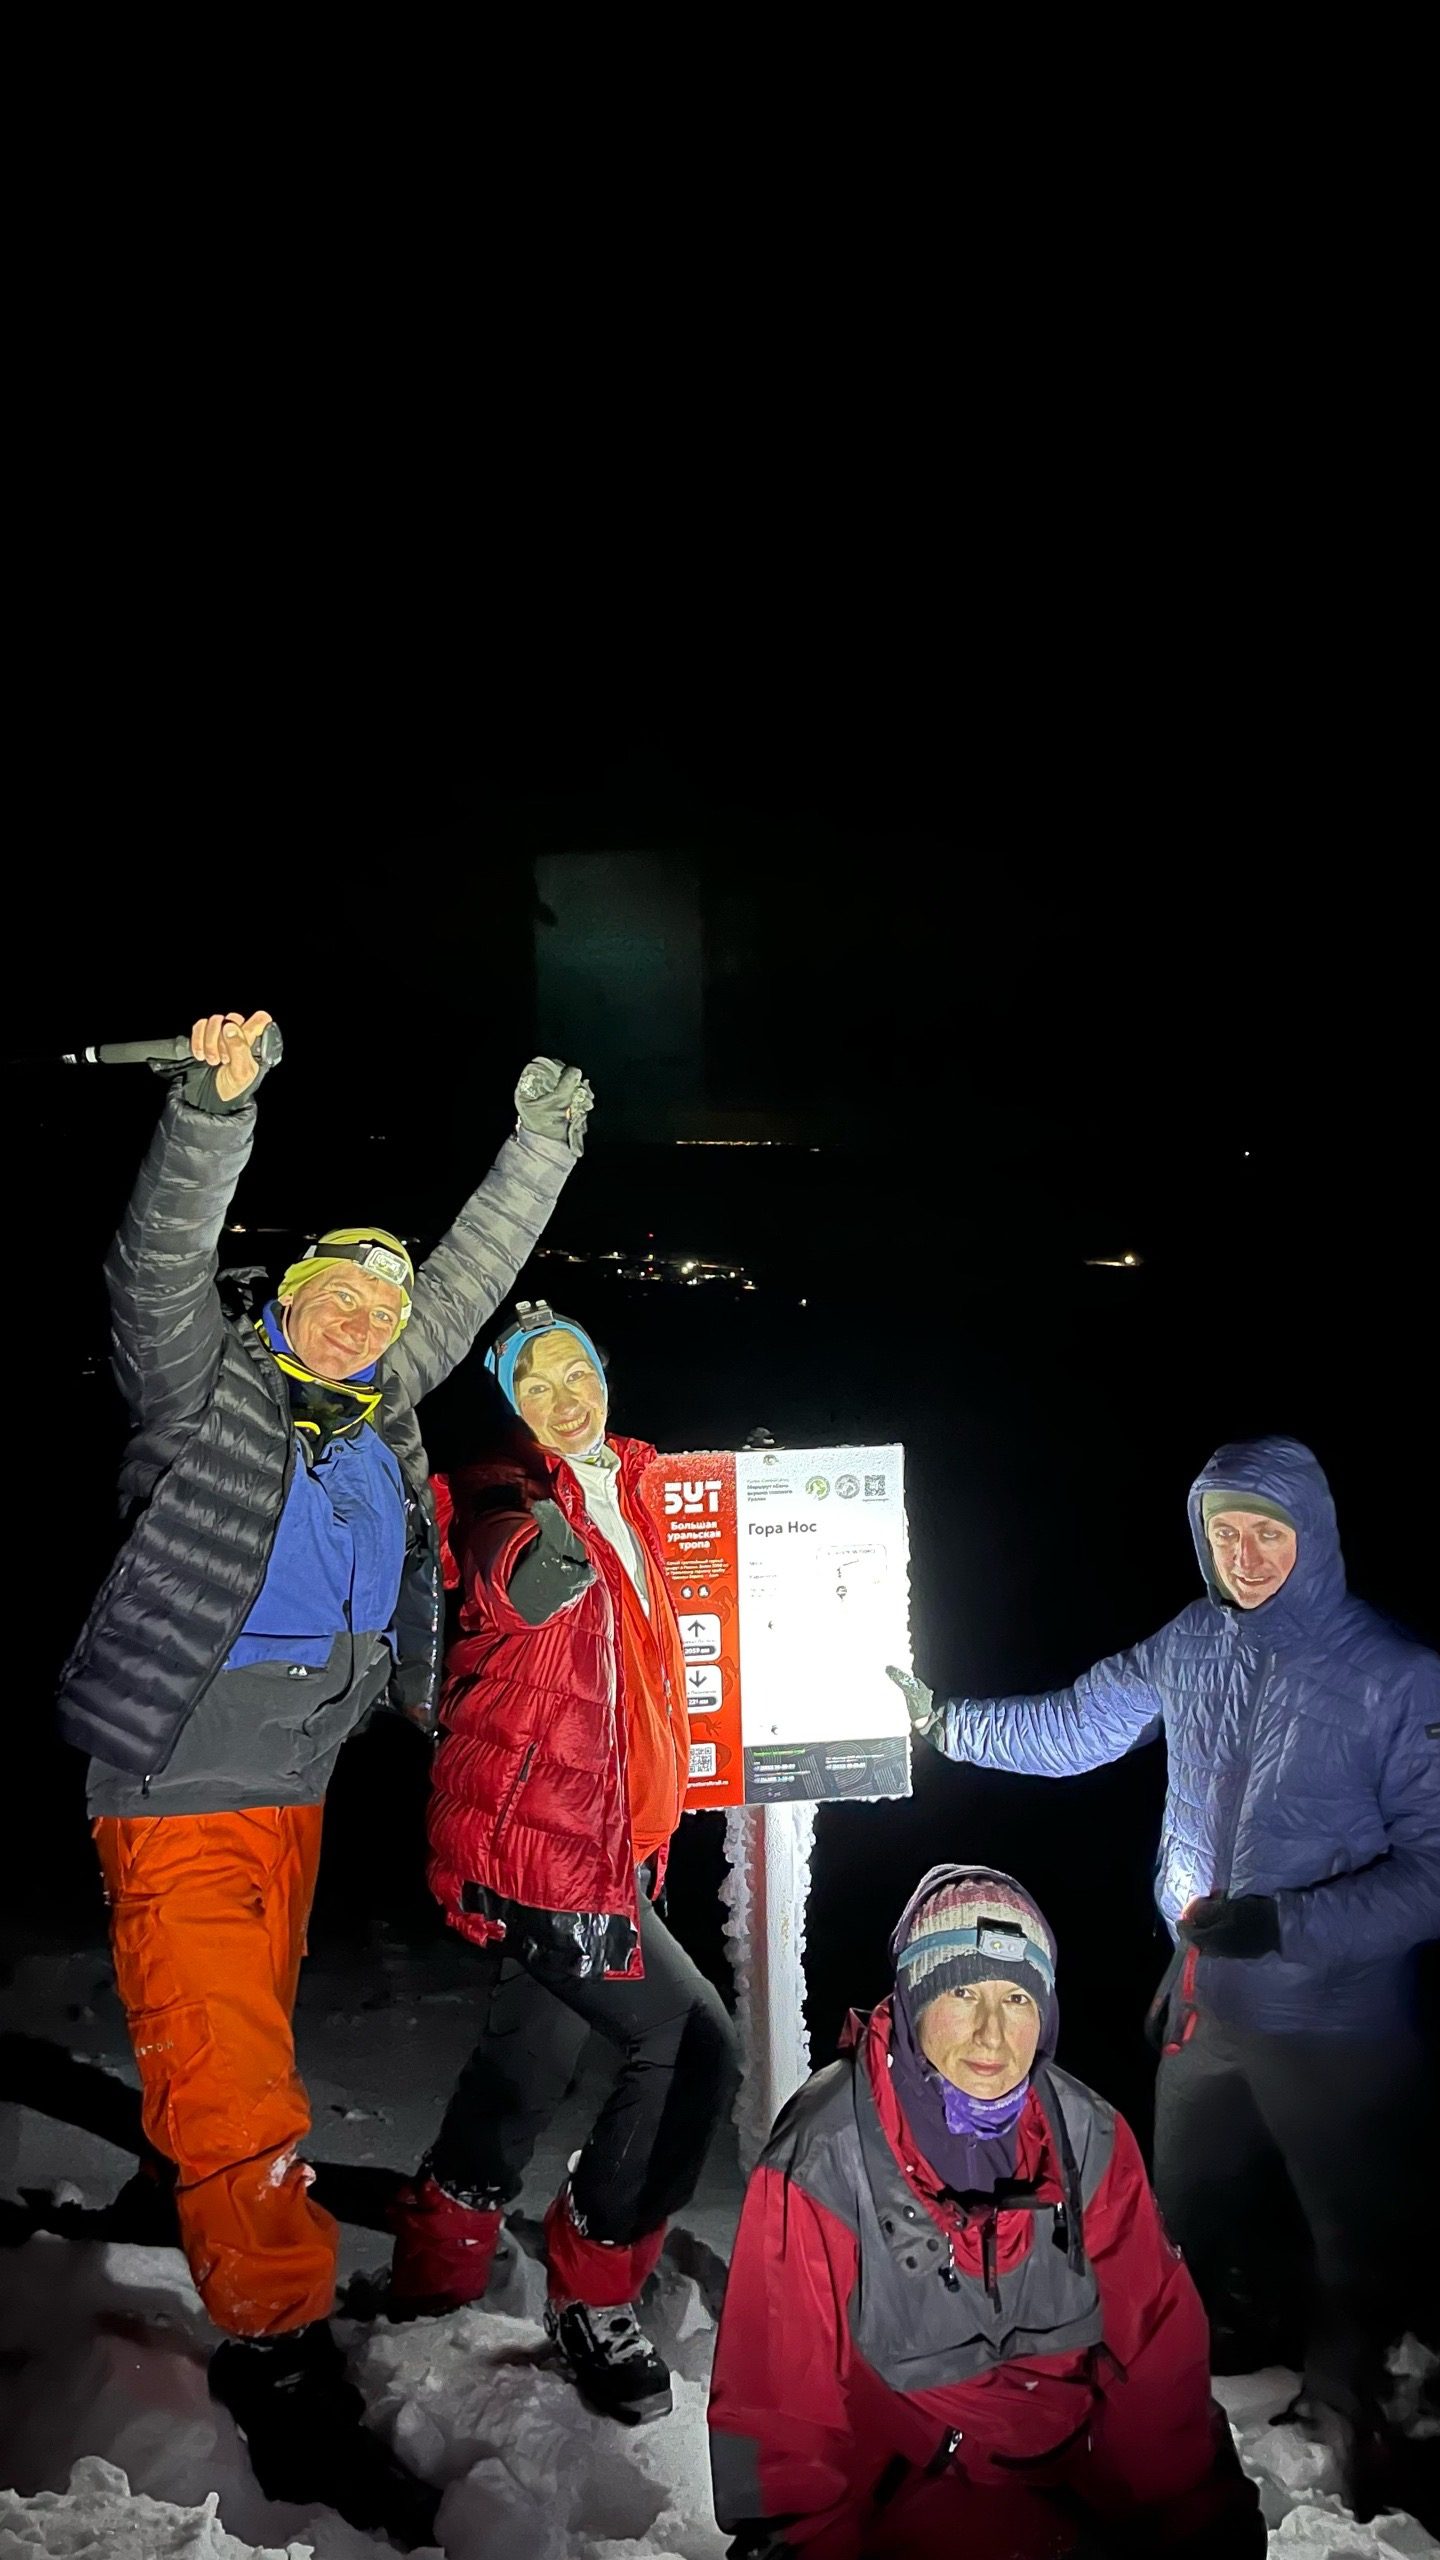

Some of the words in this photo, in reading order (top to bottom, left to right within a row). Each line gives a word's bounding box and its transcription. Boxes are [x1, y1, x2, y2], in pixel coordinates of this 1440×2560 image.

[670, 1521, 718, 1531] Большая
[748, 1523, 783, 1537] Гора
[788, 1520, 817, 1534] Нос
[667, 1530, 722, 1543] уральская
[679, 1541, 711, 1552] тропа
